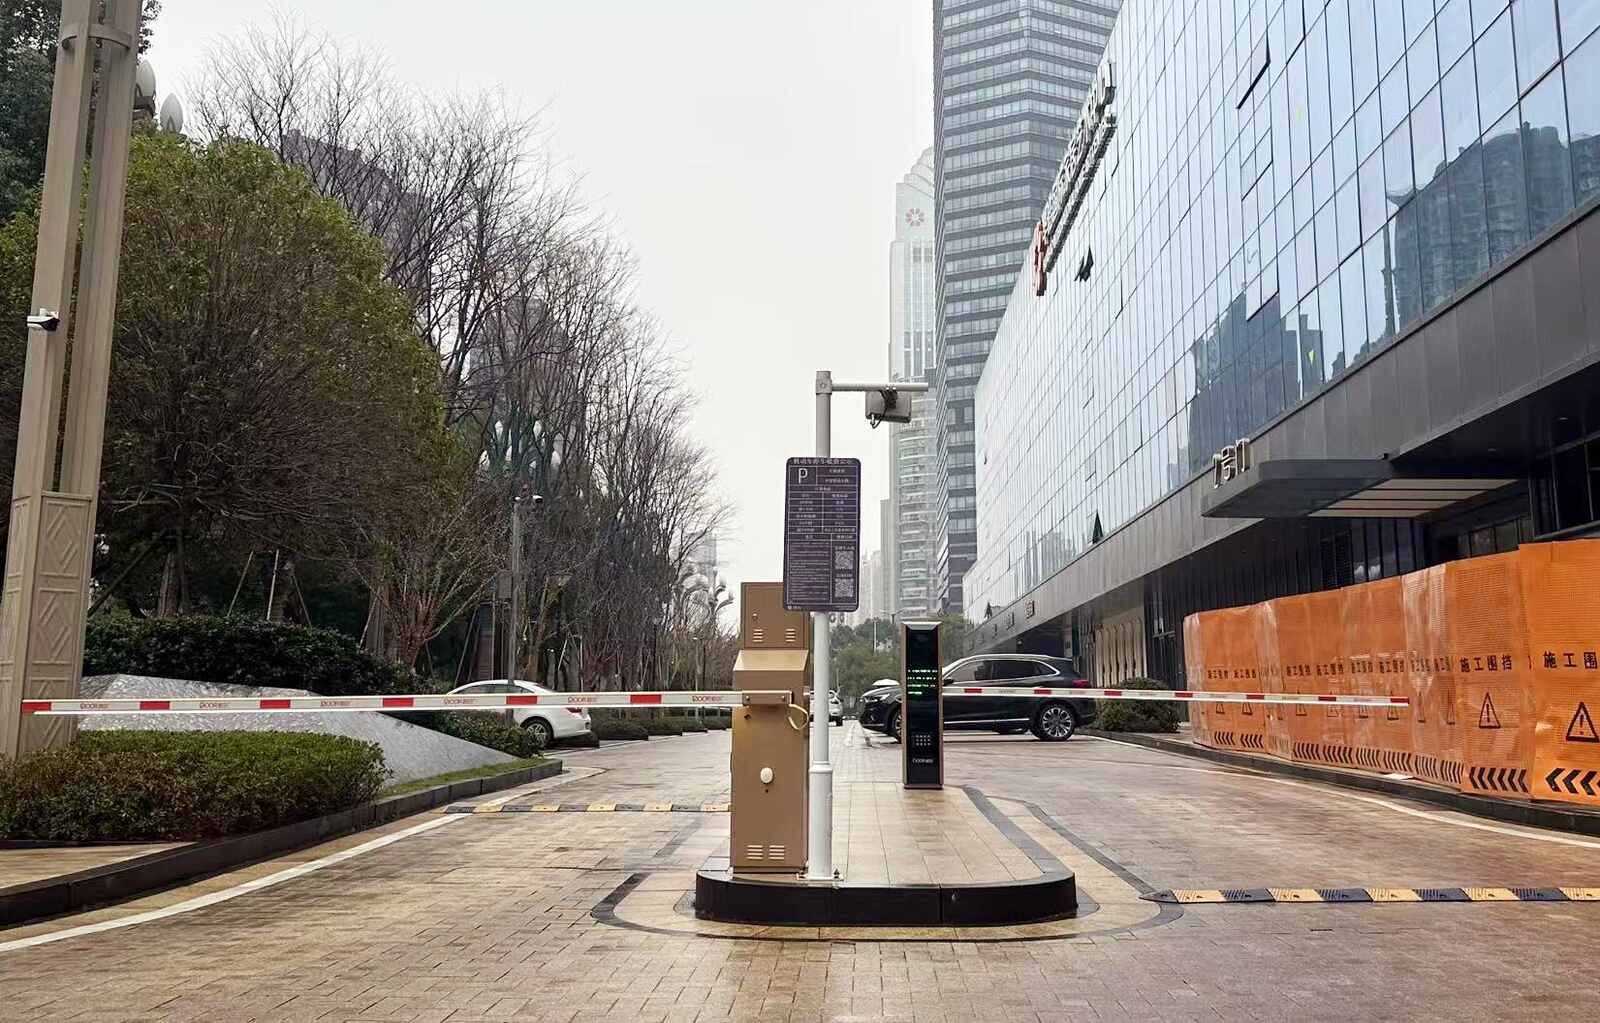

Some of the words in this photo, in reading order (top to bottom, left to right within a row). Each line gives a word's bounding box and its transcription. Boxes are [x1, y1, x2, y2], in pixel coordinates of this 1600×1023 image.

[798, 468, 808, 484] P
[1459, 654, 1513, 673] 施工围挡
[1543, 650, 1598, 669] 施工围
